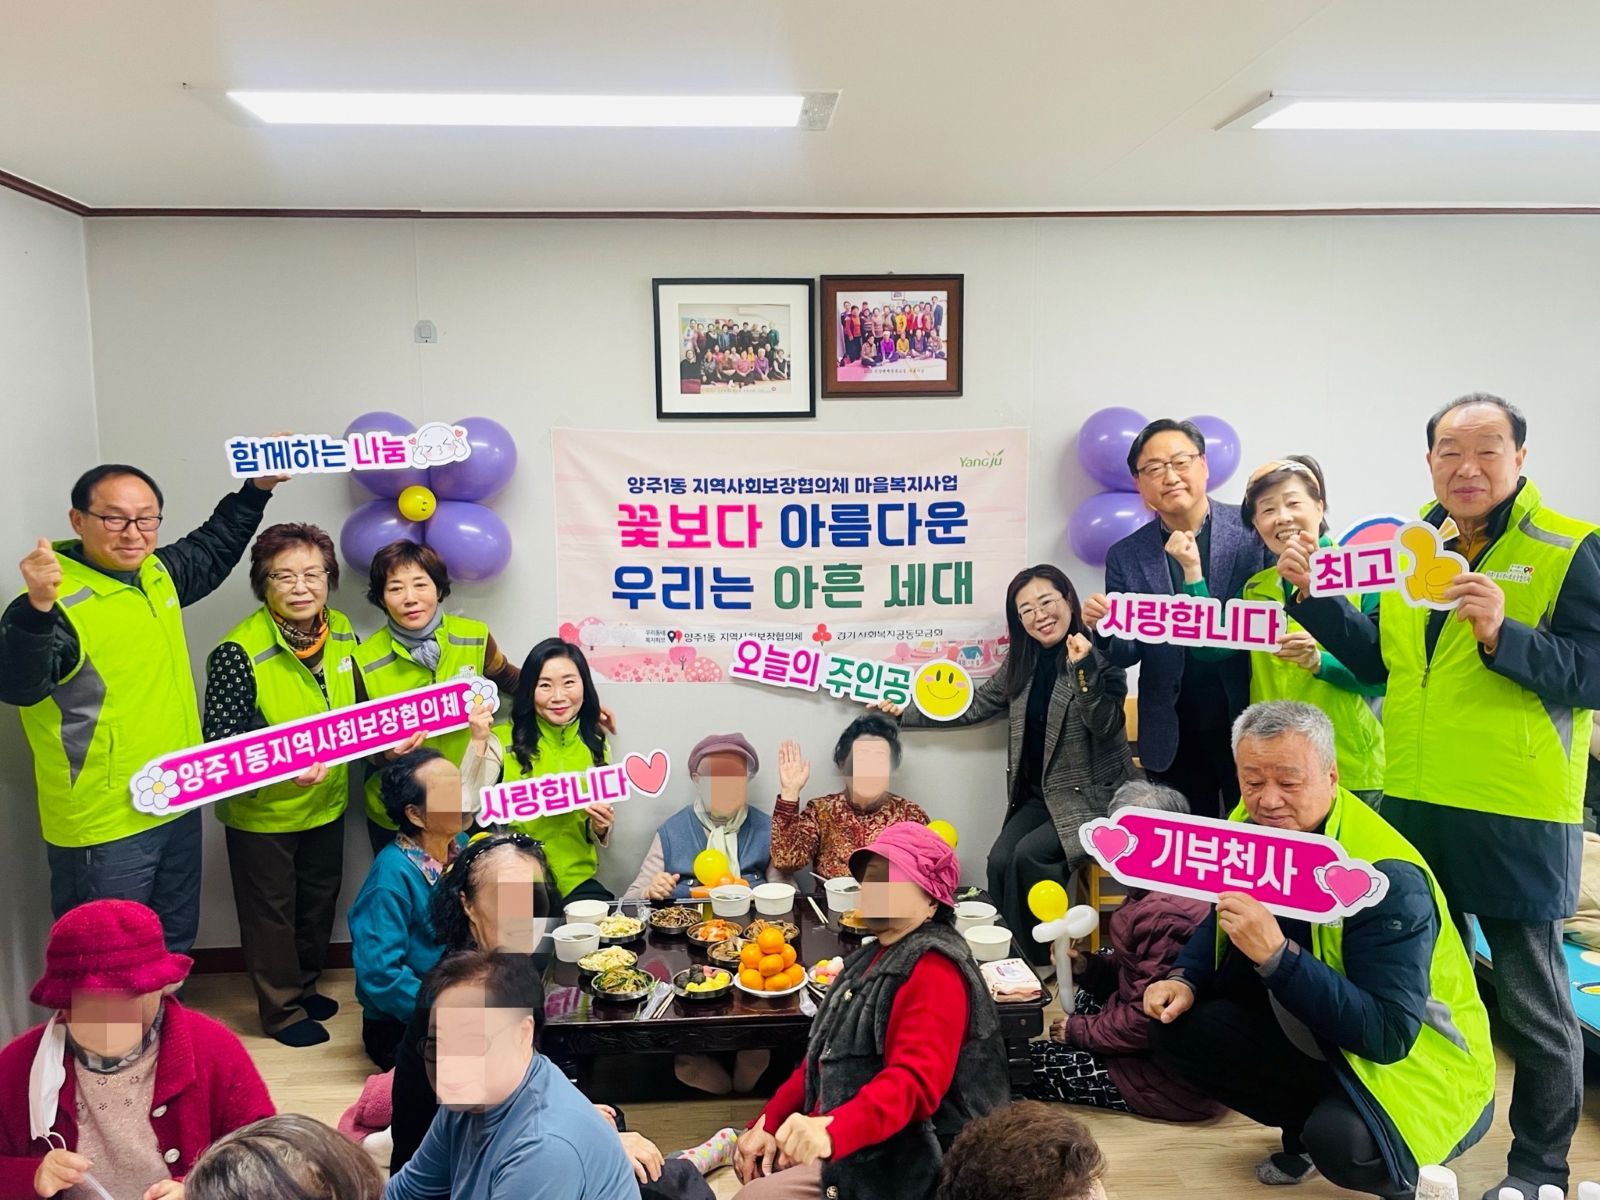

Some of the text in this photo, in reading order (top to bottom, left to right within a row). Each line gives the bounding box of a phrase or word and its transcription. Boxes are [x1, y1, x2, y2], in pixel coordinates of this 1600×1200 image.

[230, 436, 406, 473] 함께하는 나눔
[626, 475, 959, 495] 양주1동 지역사회보장협의체 마을복지사업
[617, 501, 969, 549] 꽃보다 아름다운
[611, 561, 973, 610] 우리는 아흔 세대
[1315, 547, 1396, 591] 최고
[684, 632, 717, 643] 양주1동
[1102, 599, 1280, 645] 사랑합니다
[733, 639, 911, 706] 오늘의 주인공
[179, 691, 460, 792] 양주1동지역사회보장협의체
[481, 767, 628, 822] 사랑합니다
[1151, 827, 1299, 896] 기부천사
